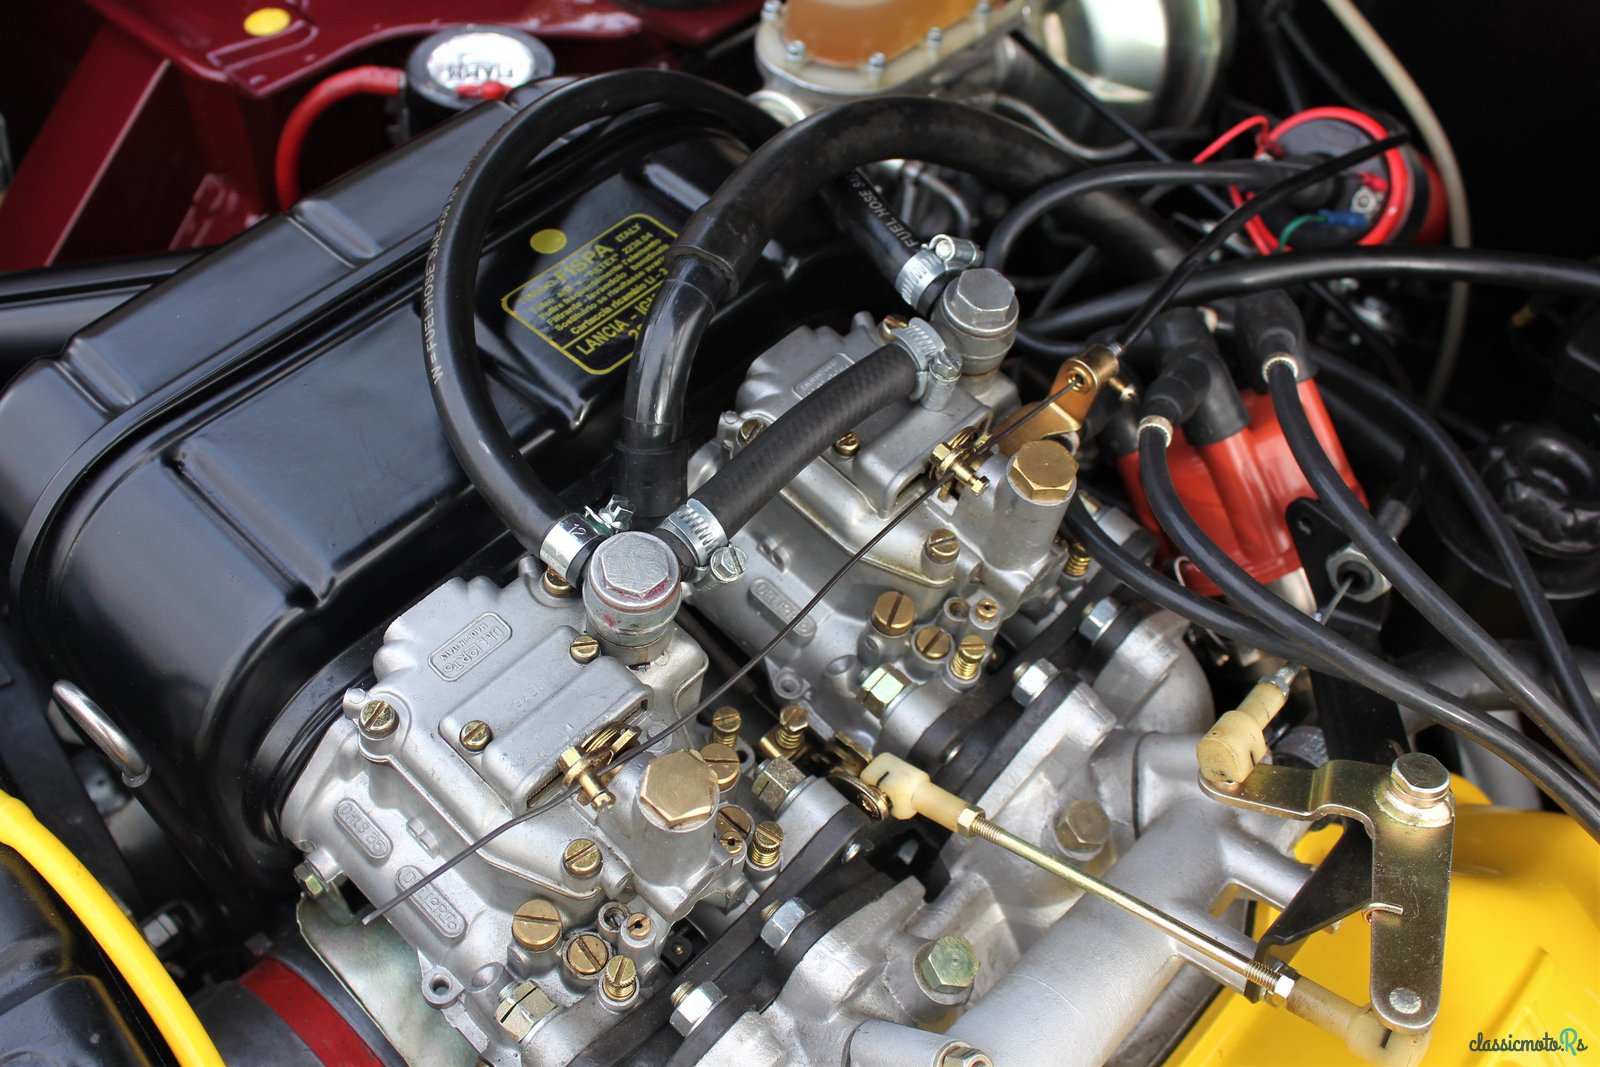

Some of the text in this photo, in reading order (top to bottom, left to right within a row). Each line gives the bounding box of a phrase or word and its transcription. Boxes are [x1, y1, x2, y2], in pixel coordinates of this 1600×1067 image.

[859, 189, 890, 218] HOSE
[428, 228, 443, 258] SAE
[886, 217, 919, 248] FUEL
[553, 243, 615, 282] FISPA
[615, 223, 641, 242] ITALY
[423, 263, 436, 312] HOSE
[570, 306, 613, 336] Cartuccia
[610, 282, 648, 309] ricambio
[424, 312, 438, 352] FUEL
[576, 318, 630, 356] LANCIA
[567, 523, 588, 538] 12
[467, 622, 488, 641] MADE
[440, 645, 461, 661] ITALY
